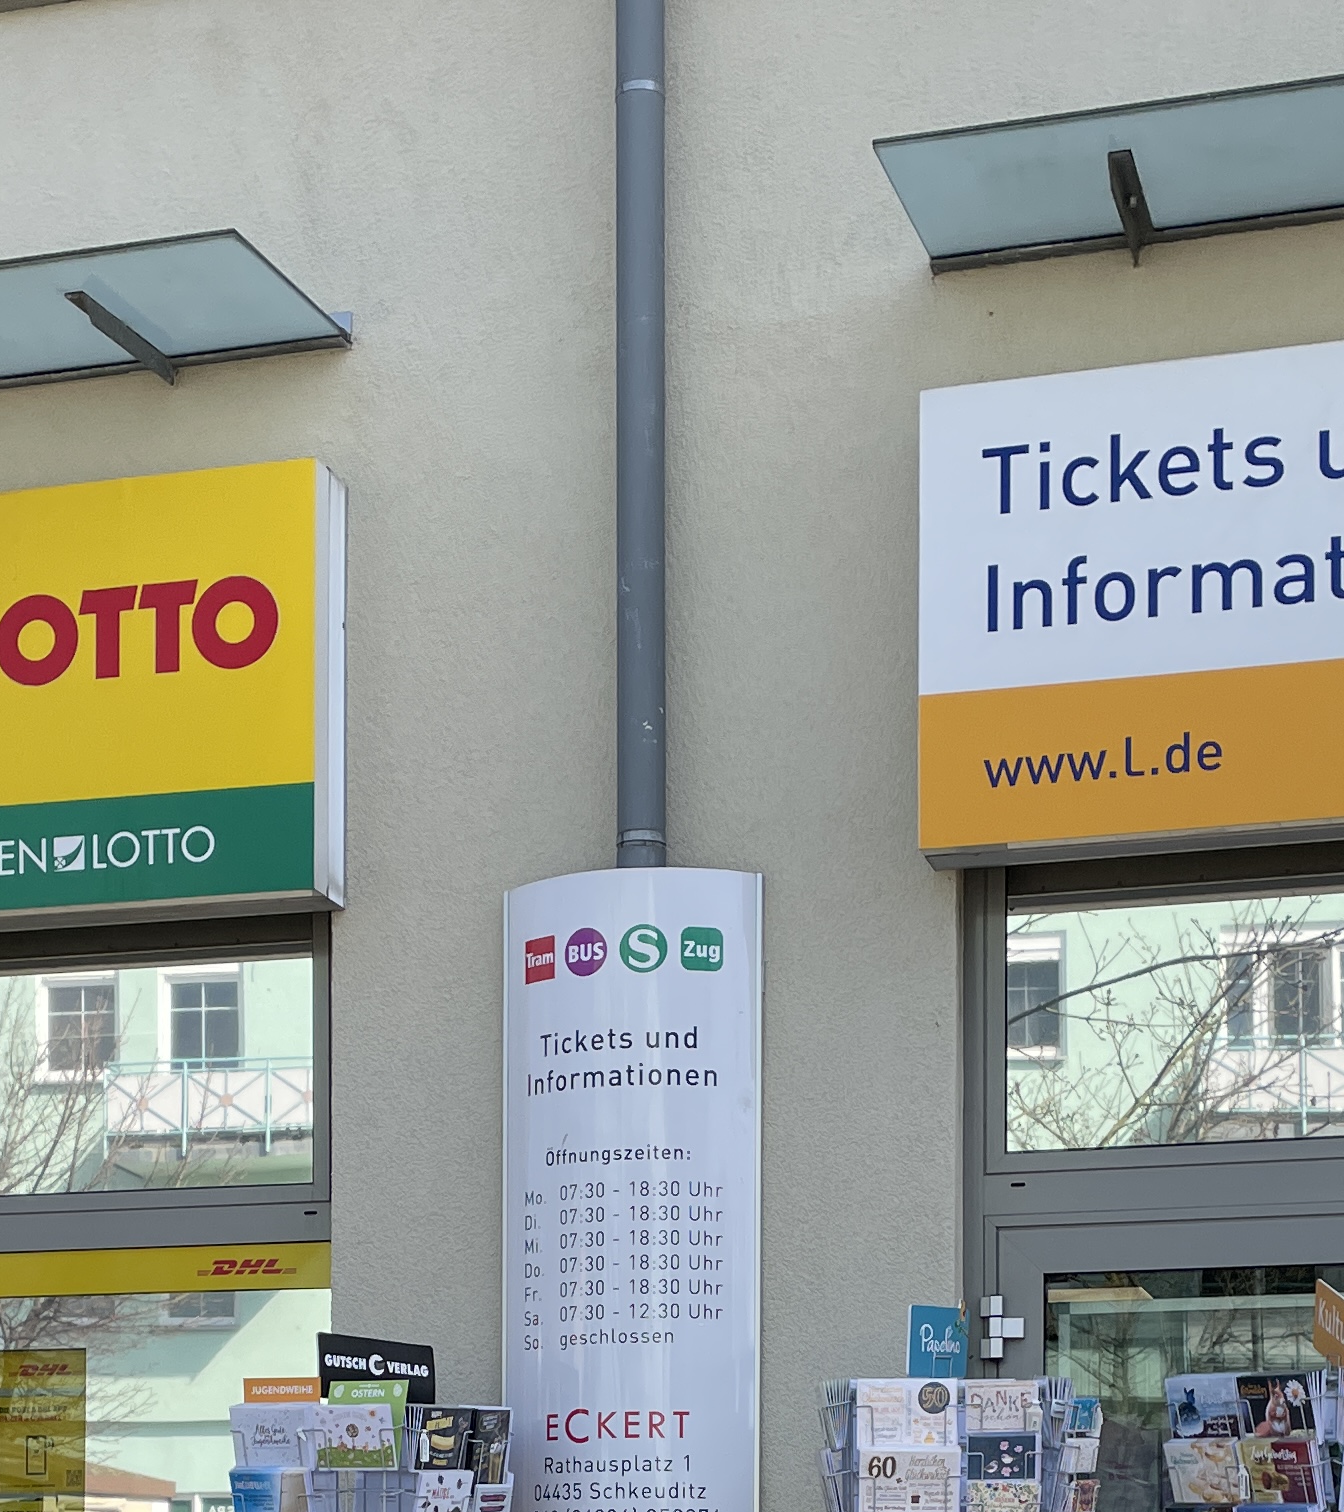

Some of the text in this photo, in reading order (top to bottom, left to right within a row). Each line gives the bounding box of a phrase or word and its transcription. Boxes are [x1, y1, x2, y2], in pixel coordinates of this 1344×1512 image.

[982, 428, 1285, 515] Tickets
[983, 730, 1223, 789] www.L.de
[93, 825, 215, 869] LOTTO
[568, 942, 605, 964] BUS
[628, 928, 661, 968] S
[684, 941, 720, 964] Zug
[526, 952, 554, 969] Tram
[540, 1026, 698, 1057] Tickets und
[527, 1063, 718, 1097] Informationen
[545, 1143, 692, 1166] Öffnungszeiten:
[524, 1191, 547, 1206] Mo.
[559, 1182, 605, 1201] 07:30
[629, 1181, 680, 1197] 18:30
[689, 1181, 723, 1198] Uhr
[524, 1215, 542, 1230] Di.
[559, 1206, 605, 1225] 07:30
[629, 1205, 680, 1221] 18:30
[689, 1205, 723, 1222] Uhr
[524, 1239, 543, 1254] Mi.
[559, 1231, 605, 1250] 07:30
[629, 1230, 680, 1246] 18:30
[689, 1230, 723, 1247] Uhr
[211, 1258, 283, 1276] DHL
[524, 1263, 545, 1278] Do.
[559, 1255, 605, 1274] 07:30
[629, 1254, 680, 1270] 18:30
[689, 1254, 723, 1271] Uhr
[524, 1287, 542, 1302] Fr.
[559, 1280, 605, 1299] 07:30
[629, 1279, 680, 1295] 18:30
[689, 1279, 723, 1296] Uhr
[524, 1311, 544, 1326] Sa.
[559, 1304, 605, 1323] 07:30
[629, 1303, 680, 1319] 12:30
[689, 1303, 723, 1320] Uhr
[524, 1328, 675, 1350] So. geschlossen
[19, 1364, 72, 1376] DHL
[324, 1354, 429, 1377] GUTSCH VERLAG
[251, 1385, 313, 1395] JUGENDWEIHE
[351, 1388, 385, 1398] OSTERN
[922, 1387, 948, 1409] 50
[970, 1390, 1032, 1413] DANKE
[546, 1408, 690, 1443] ECKERT
[544, 1455, 691, 1476] Rathausplatz 1
[868, 1456, 896, 1479] 60
[535, 1482, 707, 1501] 04435 Schkeuditz
